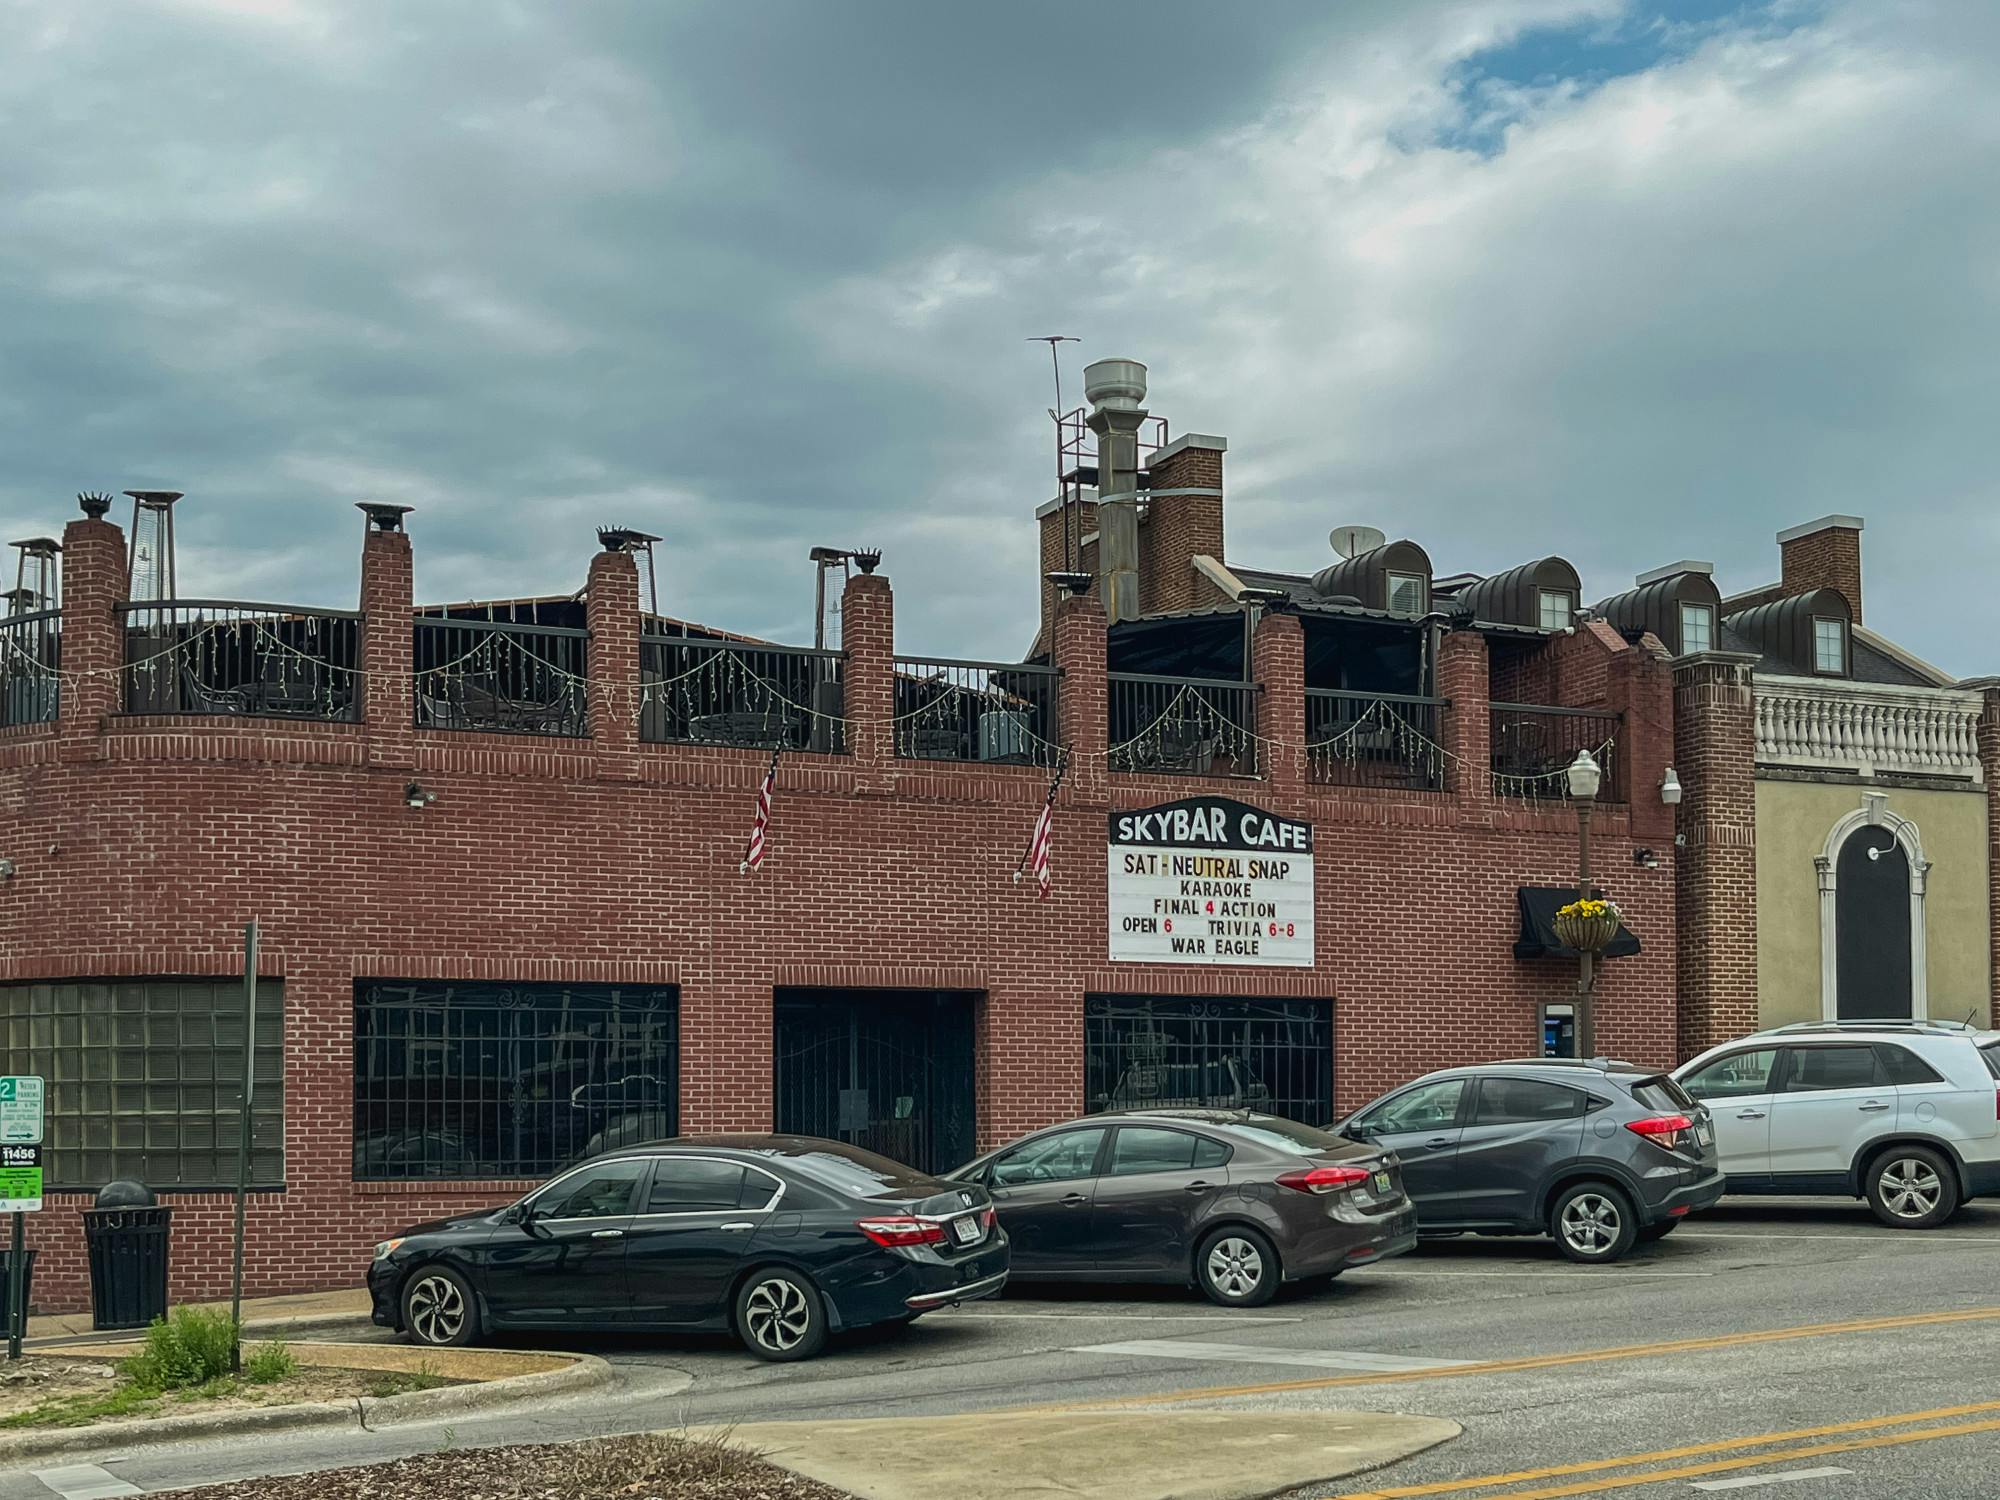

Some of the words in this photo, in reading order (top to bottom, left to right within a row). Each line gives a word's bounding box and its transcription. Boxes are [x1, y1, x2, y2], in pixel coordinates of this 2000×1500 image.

[1118, 807, 1228, 842] SKYBAR
[1240, 813, 1307, 849] CAFE
[1124, 854, 1157, 874] SAT
[1172, 855, 1243, 878] NEUTRAL
[1248, 859, 1290, 880] SNAP
[1180, 880, 1252, 898] KARAOKE
[1154, 899, 1199, 915] FINAL
[1205, 900, 1215, 915] 4
[1221, 901, 1276, 918] ACTION
[1122, 917, 1157, 933] OPEN
[1163, 919, 1172, 933] 6
[1208, 920, 1261, 937] TRIVIA
[1268, 922, 1295, 937] 6-8
[1171, 938, 1206, 954] WAR
[1215, 939, 1259, 955] EAGLE
